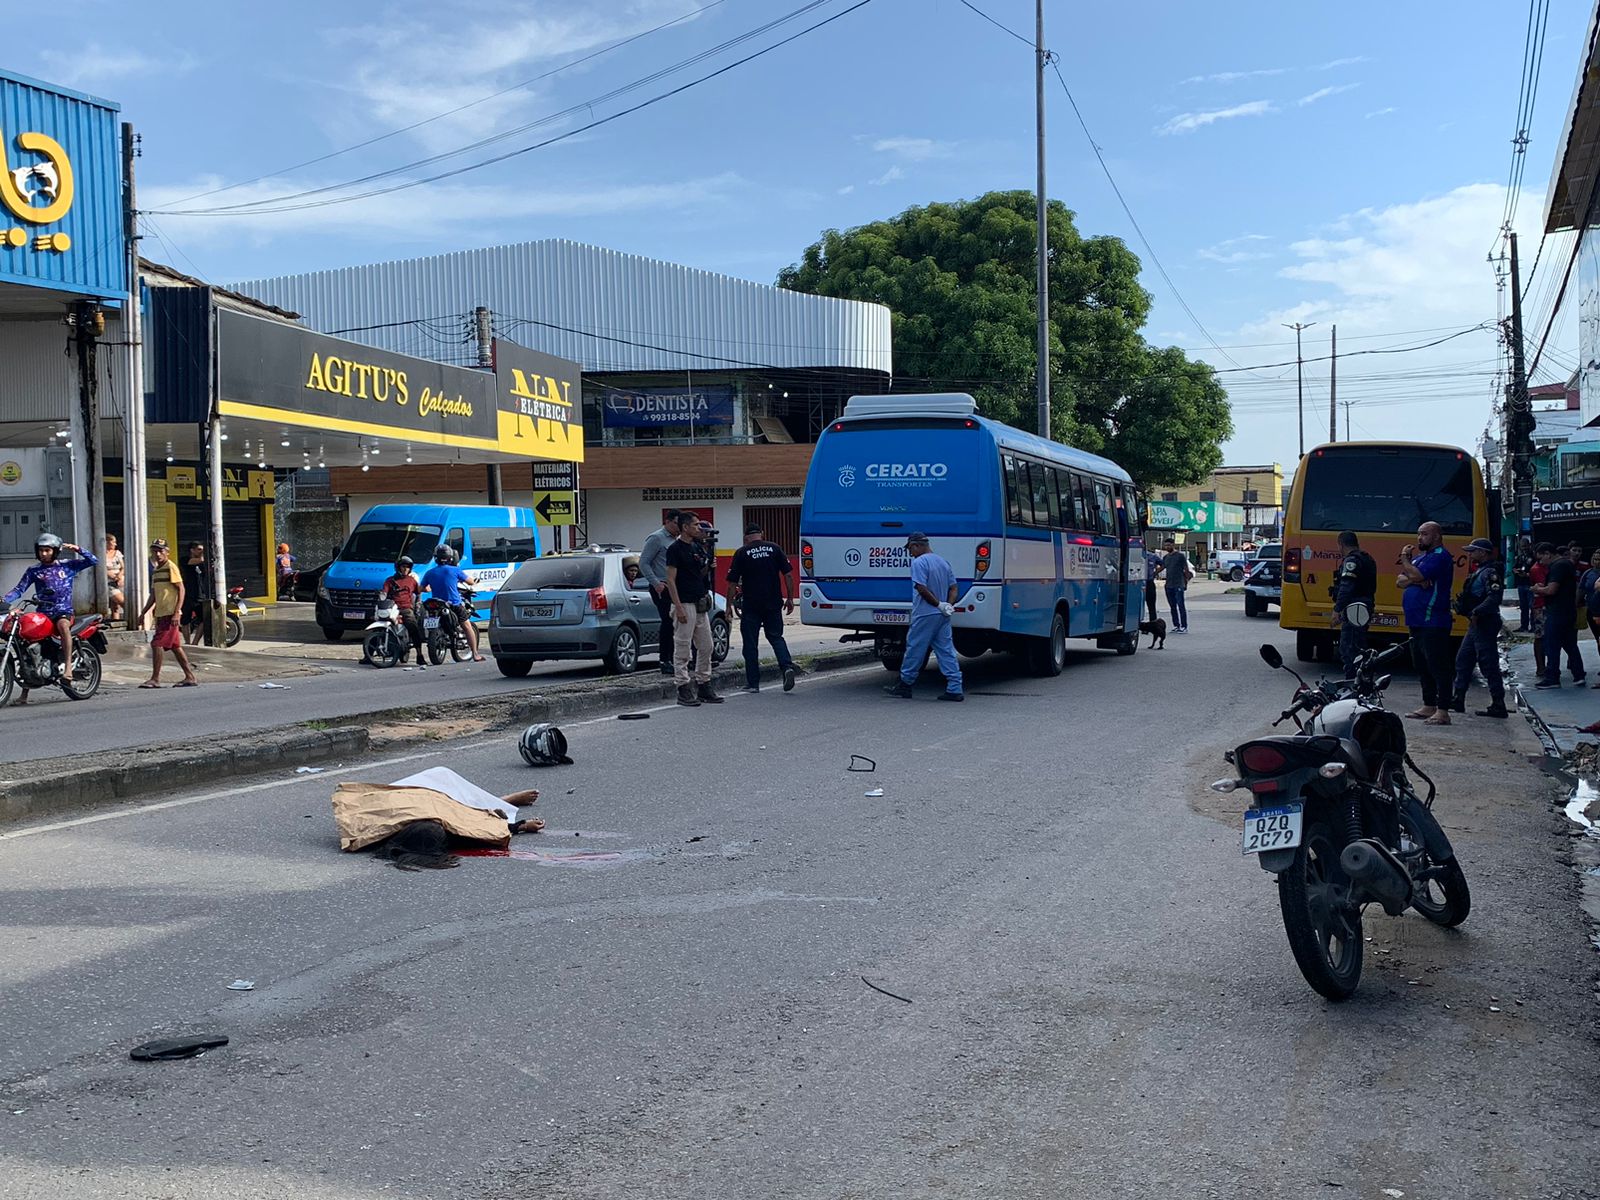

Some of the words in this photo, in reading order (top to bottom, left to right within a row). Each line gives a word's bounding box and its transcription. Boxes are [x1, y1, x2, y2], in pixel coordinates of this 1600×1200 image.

[306, 353, 409, 405] AGITU'S
[418, 387, 473, 417] Calçados
[636, 394, 708, 411] DENTISTA
[520, 397, 567, 422] ELÉTRICA
[533, 463, 571, 474] MATERIAIS
[865, 463, 948, 477] CERATO
[534, 475, 571, 488] ELÉTRICOS
[746, 545, 774, 555] POLÍCIA
[752, 551, 770, 559] CIVIL
[1078, 546, 1100, 563] CERATO
[847, 553, 859, 562] 10
[480, 569, 507, 581] CERATO
[1306, 573, 1316, 584] A
[1262, 809, 1283, 817] BRASIL
[1256, 815, 1289, 833] QZQ
[1249, 830, 1293, 849] 2C79
